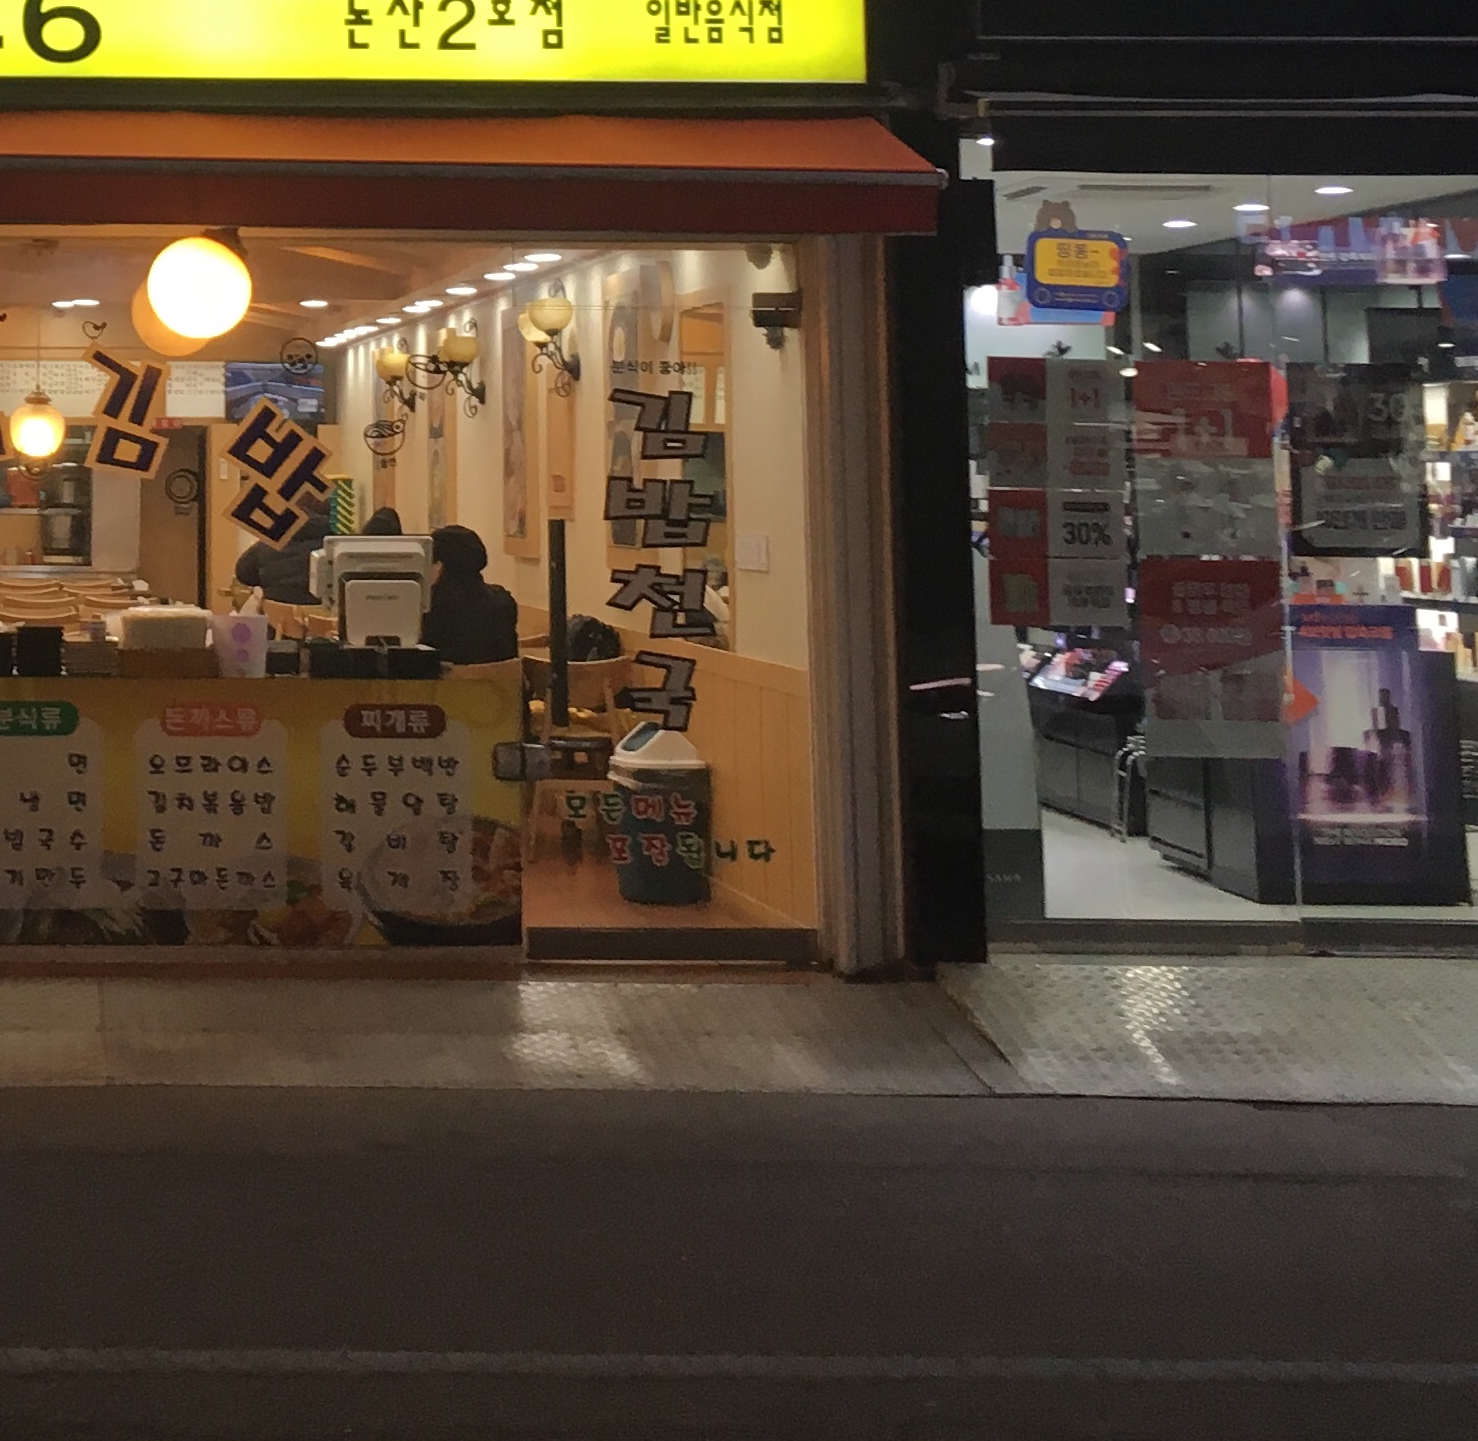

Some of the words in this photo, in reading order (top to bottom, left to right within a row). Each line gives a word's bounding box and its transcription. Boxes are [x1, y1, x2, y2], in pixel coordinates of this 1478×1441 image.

[1062, 521, 1113, 547] 30%
[604, 388, 719, 732] 김밥천국
[360, 709, 432, 733] 찌개류
